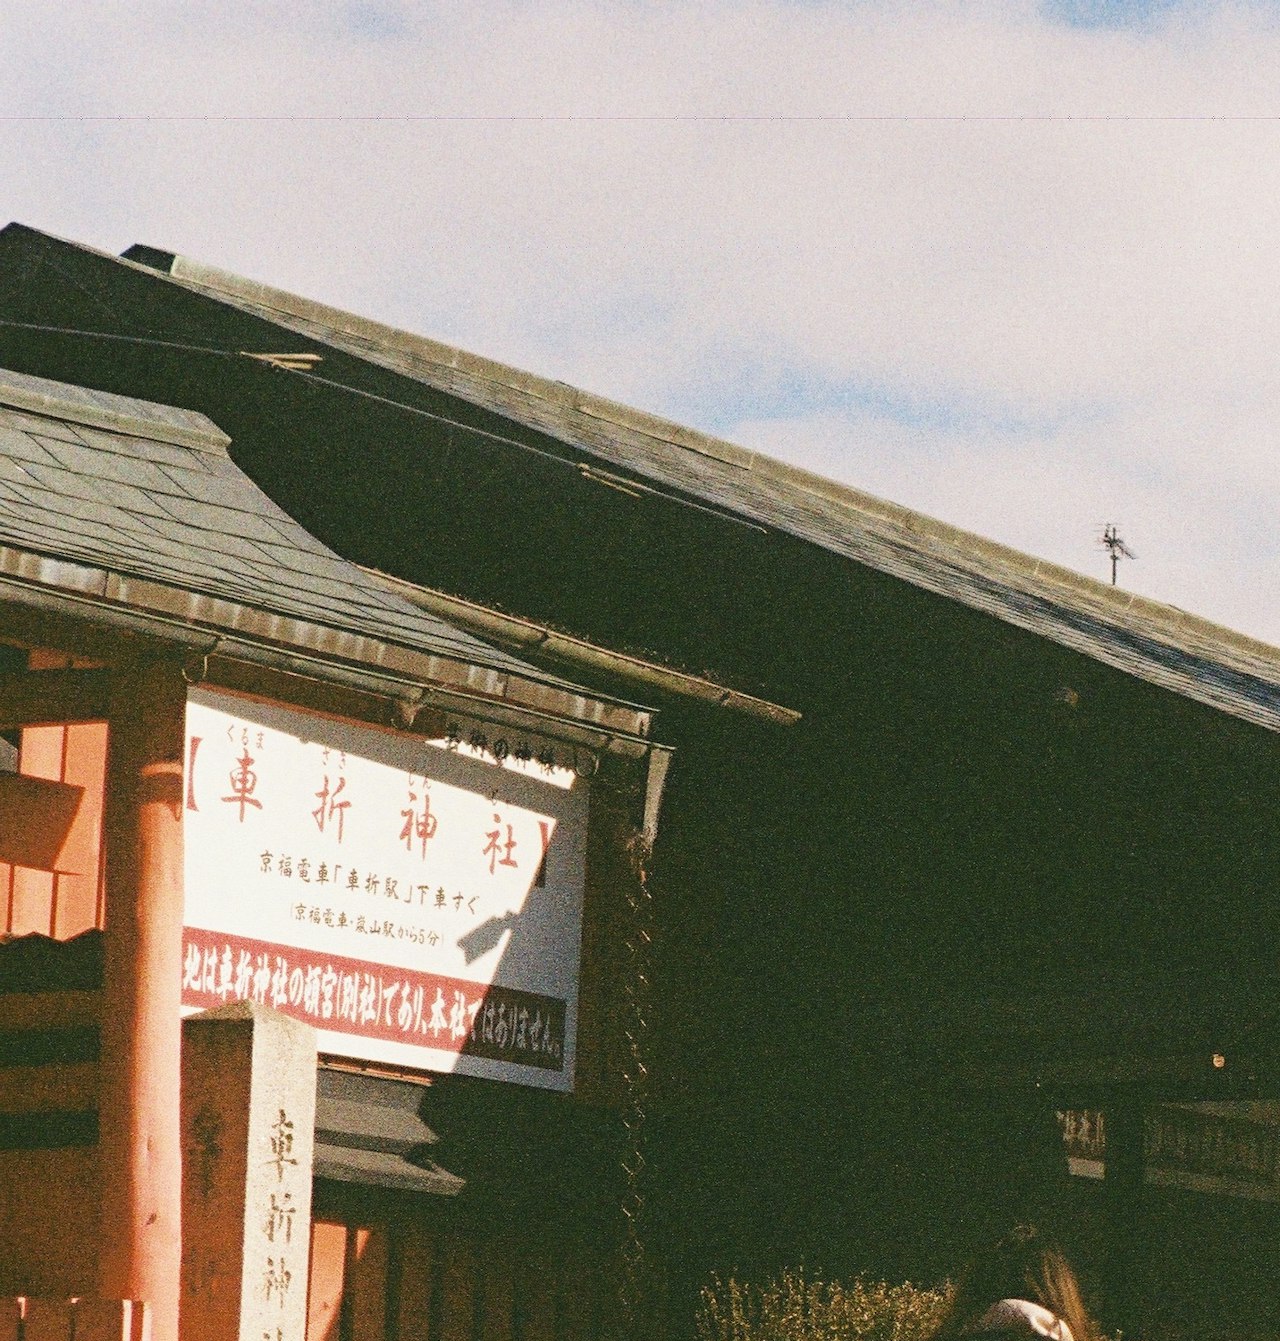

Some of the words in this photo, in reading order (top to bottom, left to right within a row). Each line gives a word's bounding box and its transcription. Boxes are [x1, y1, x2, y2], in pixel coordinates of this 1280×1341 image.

[260, 849, 480, 915] 京福電車「車折駅」下車すぐ
